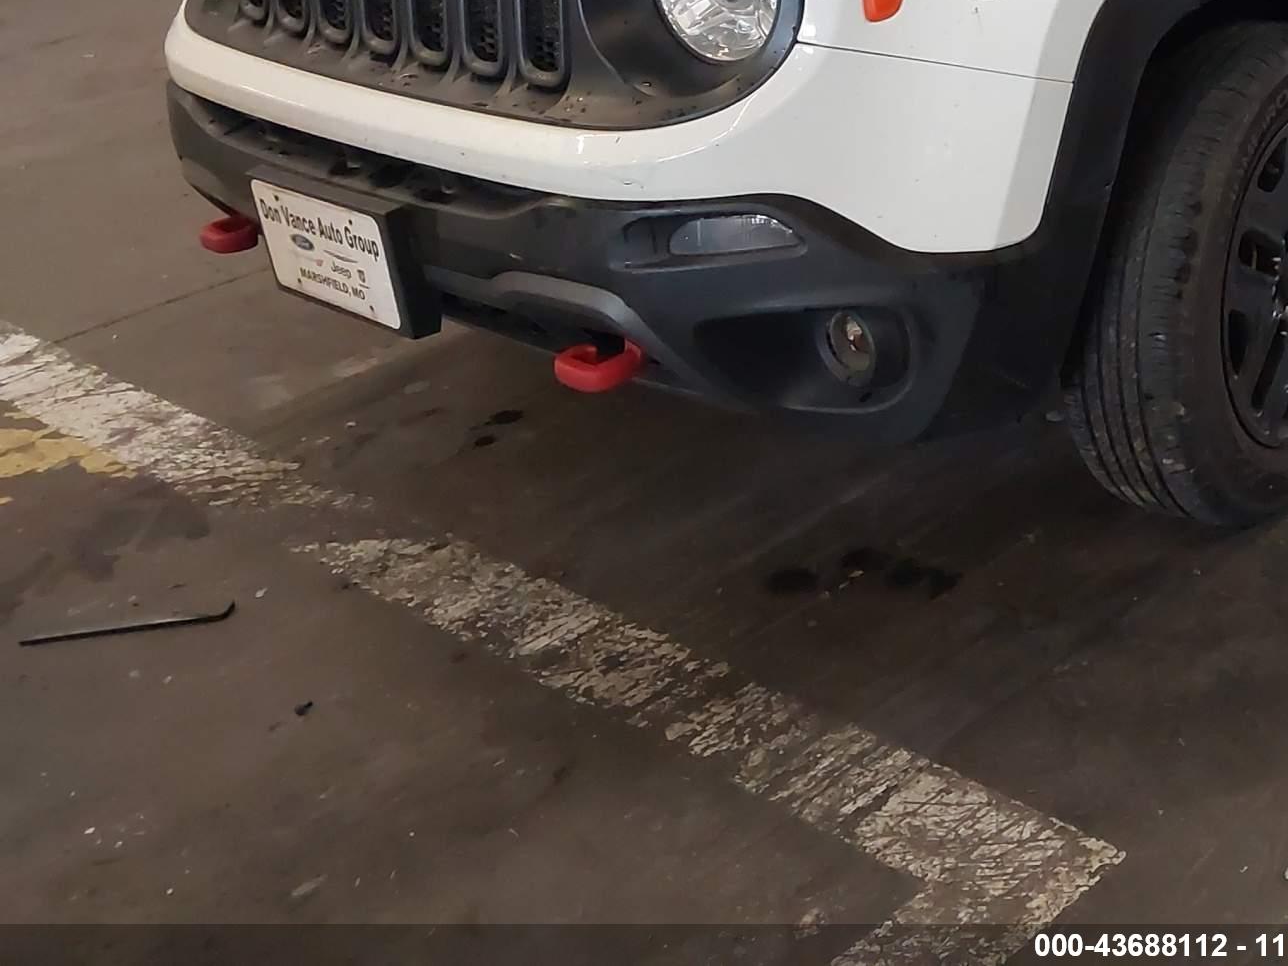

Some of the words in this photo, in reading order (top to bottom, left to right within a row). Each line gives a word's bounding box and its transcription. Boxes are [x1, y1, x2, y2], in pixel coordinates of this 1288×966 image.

[259, 198, 281, 224] Don
[281, 205, 317, 235] Vance
[318, 217, 344, 245] Auto
[344, 225, 380, 263] Group
[351, 288, 366, 301] MO
